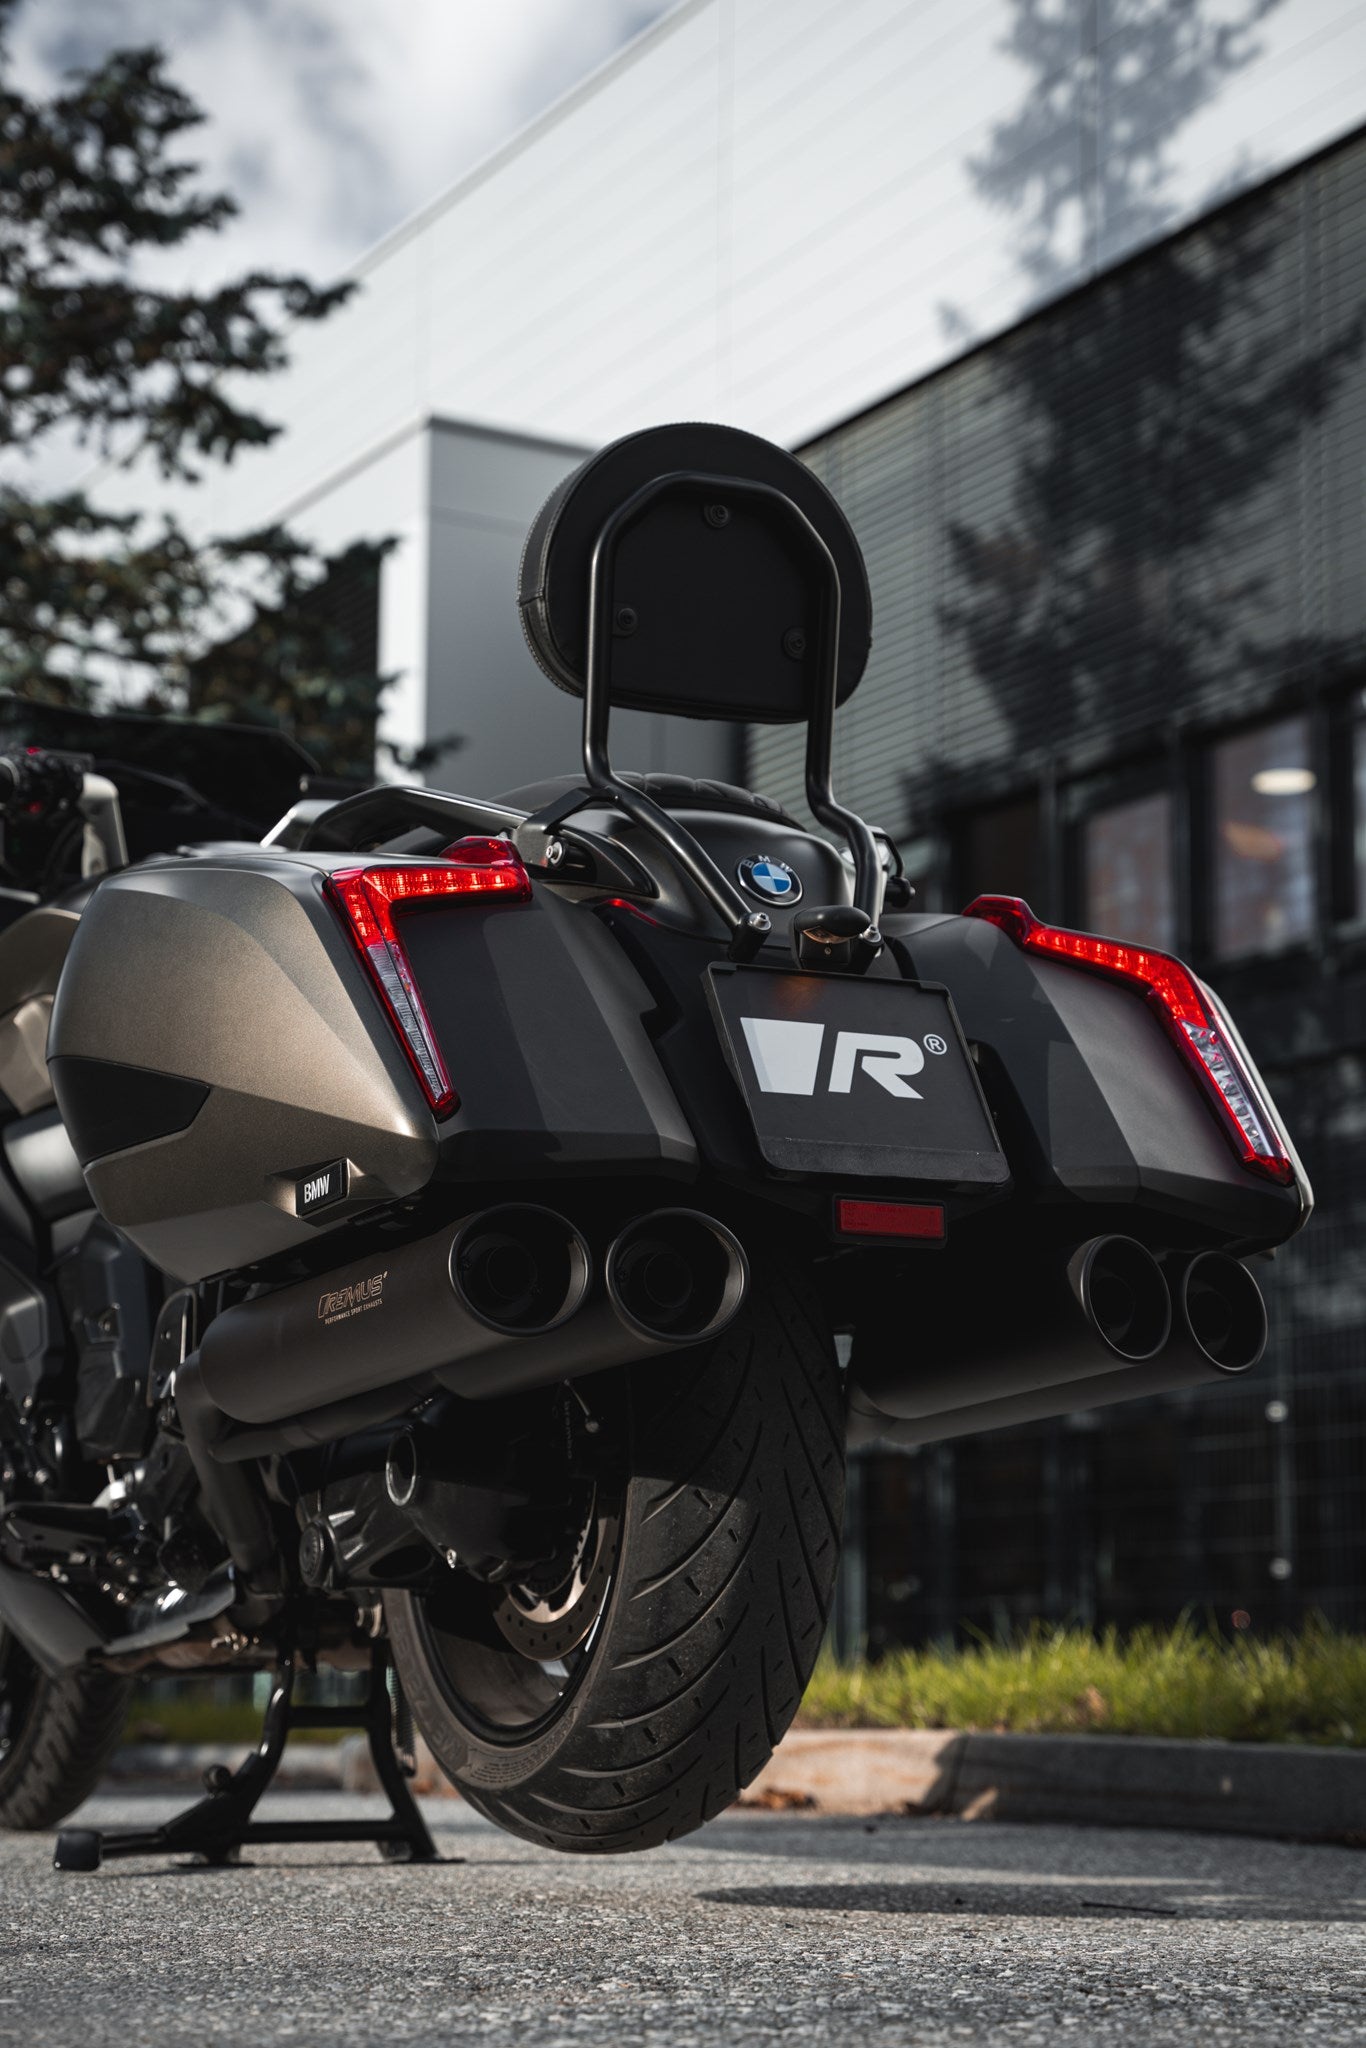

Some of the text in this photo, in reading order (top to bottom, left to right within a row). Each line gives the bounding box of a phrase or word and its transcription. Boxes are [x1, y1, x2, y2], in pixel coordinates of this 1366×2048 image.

[741, 855, 793, 872] BMW
[303, 1173, 330, 1204] BMW
[317, 1274, 384, 1319] REMUS
[324, 1298, 383, 1325] PERFORMANCE SPORT EXHAUSTS
